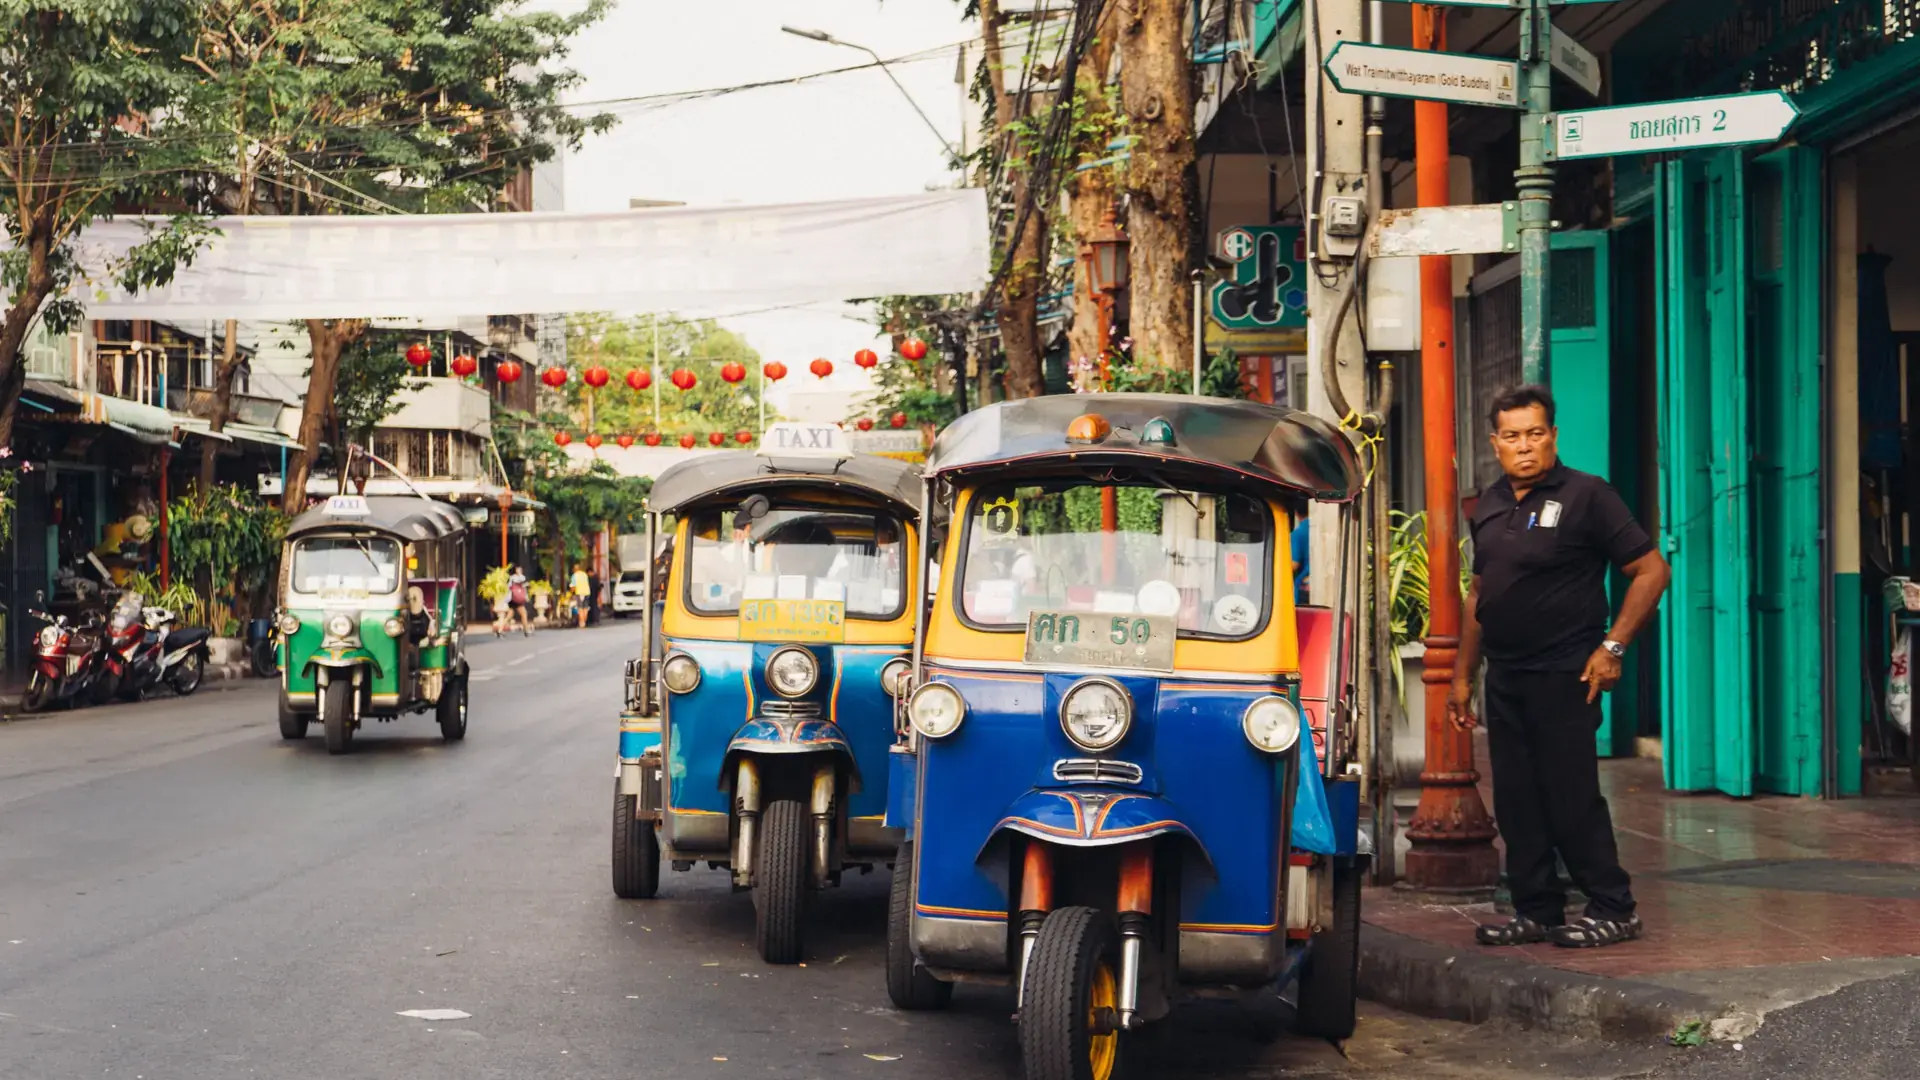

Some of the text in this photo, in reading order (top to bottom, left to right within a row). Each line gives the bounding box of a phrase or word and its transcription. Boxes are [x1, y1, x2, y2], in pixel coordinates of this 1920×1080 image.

[1345, 62, 1361, 77] Wat
[1712, 109, 1727, 132] 2
[775, 427, 835, 449] TAXI
[333, 499, 360, 509] TAXI
[1110, 616, 1150, 645] 50
